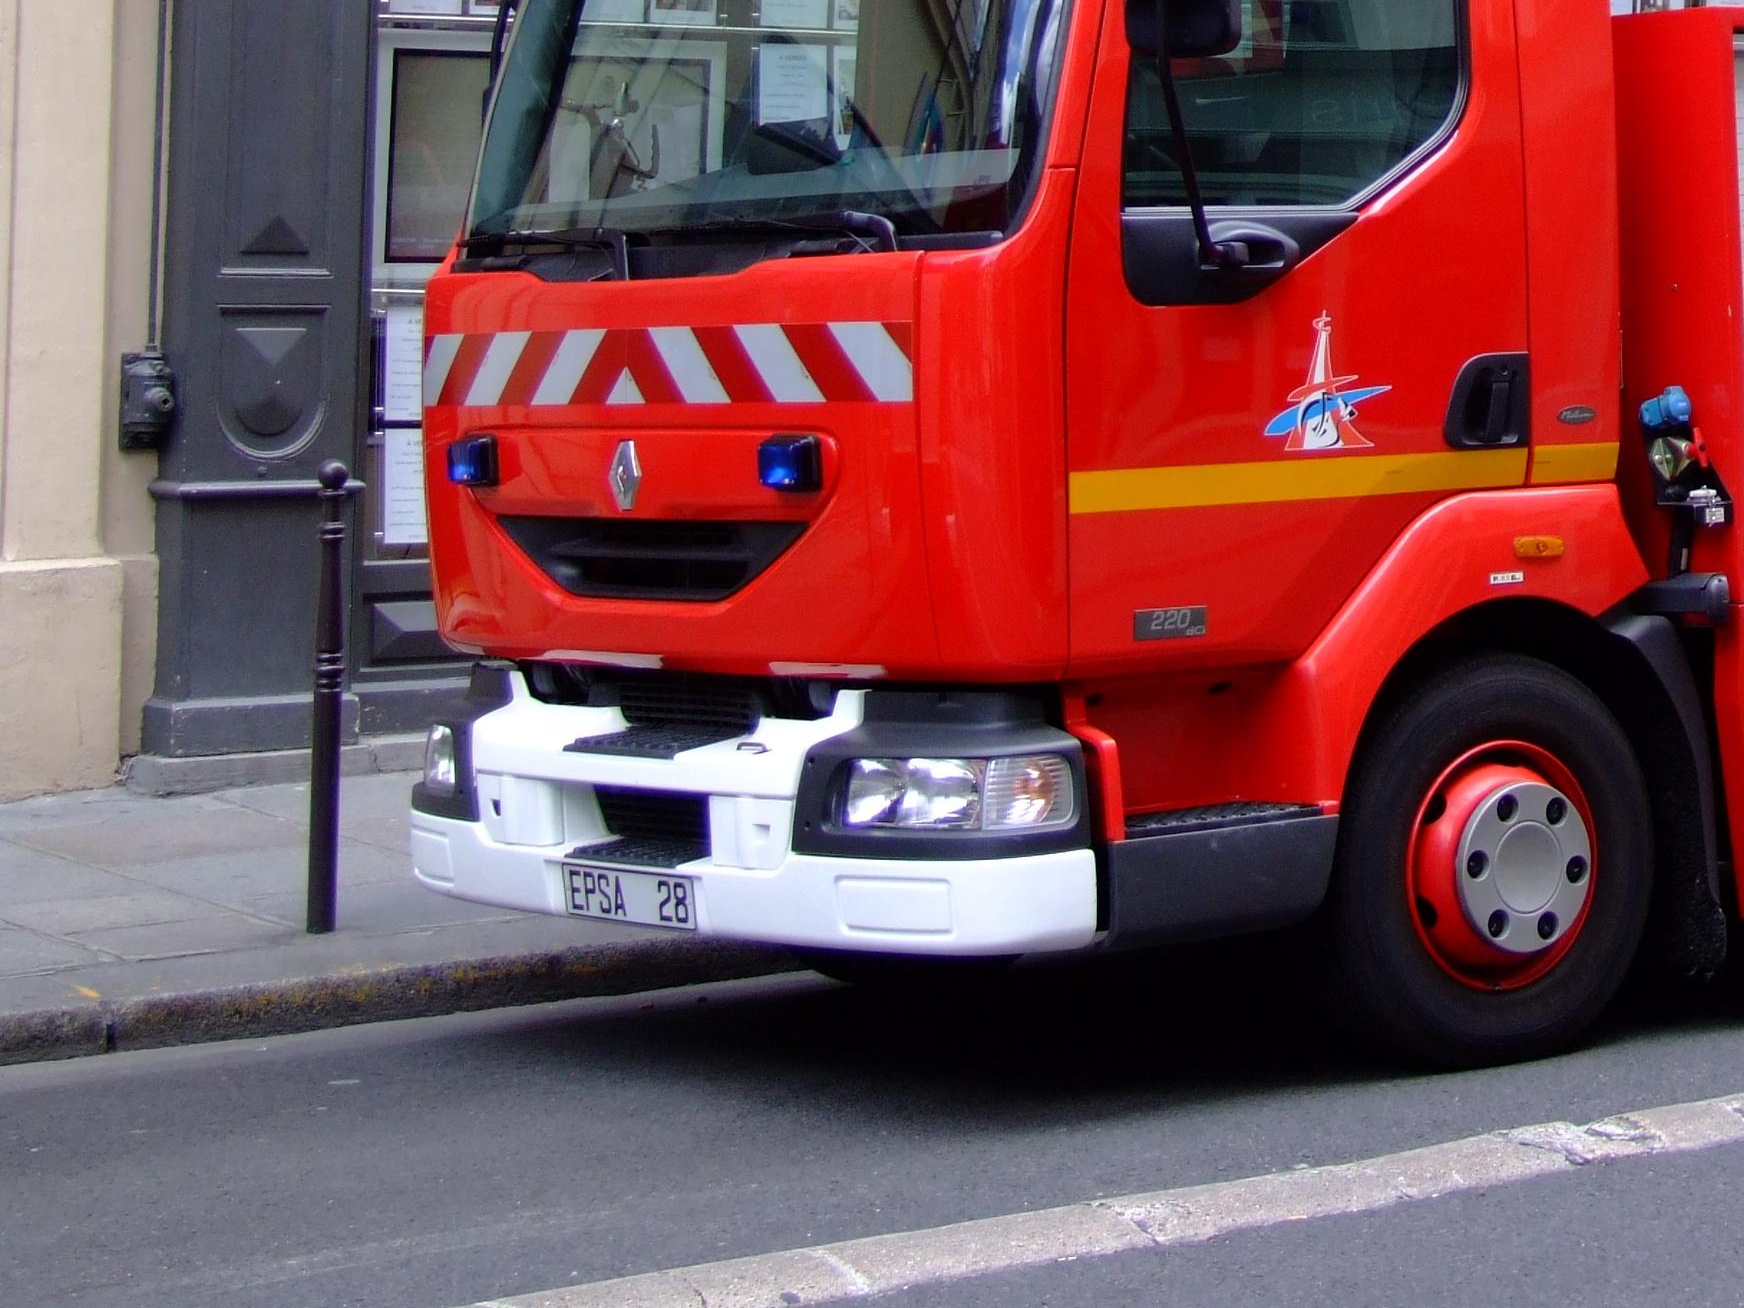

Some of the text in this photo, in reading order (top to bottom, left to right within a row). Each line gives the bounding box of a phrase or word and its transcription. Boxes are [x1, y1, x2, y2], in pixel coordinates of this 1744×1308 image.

[1150, 609, 1191, 630] 220
[569, 869, 689, 924] EPSA 28
